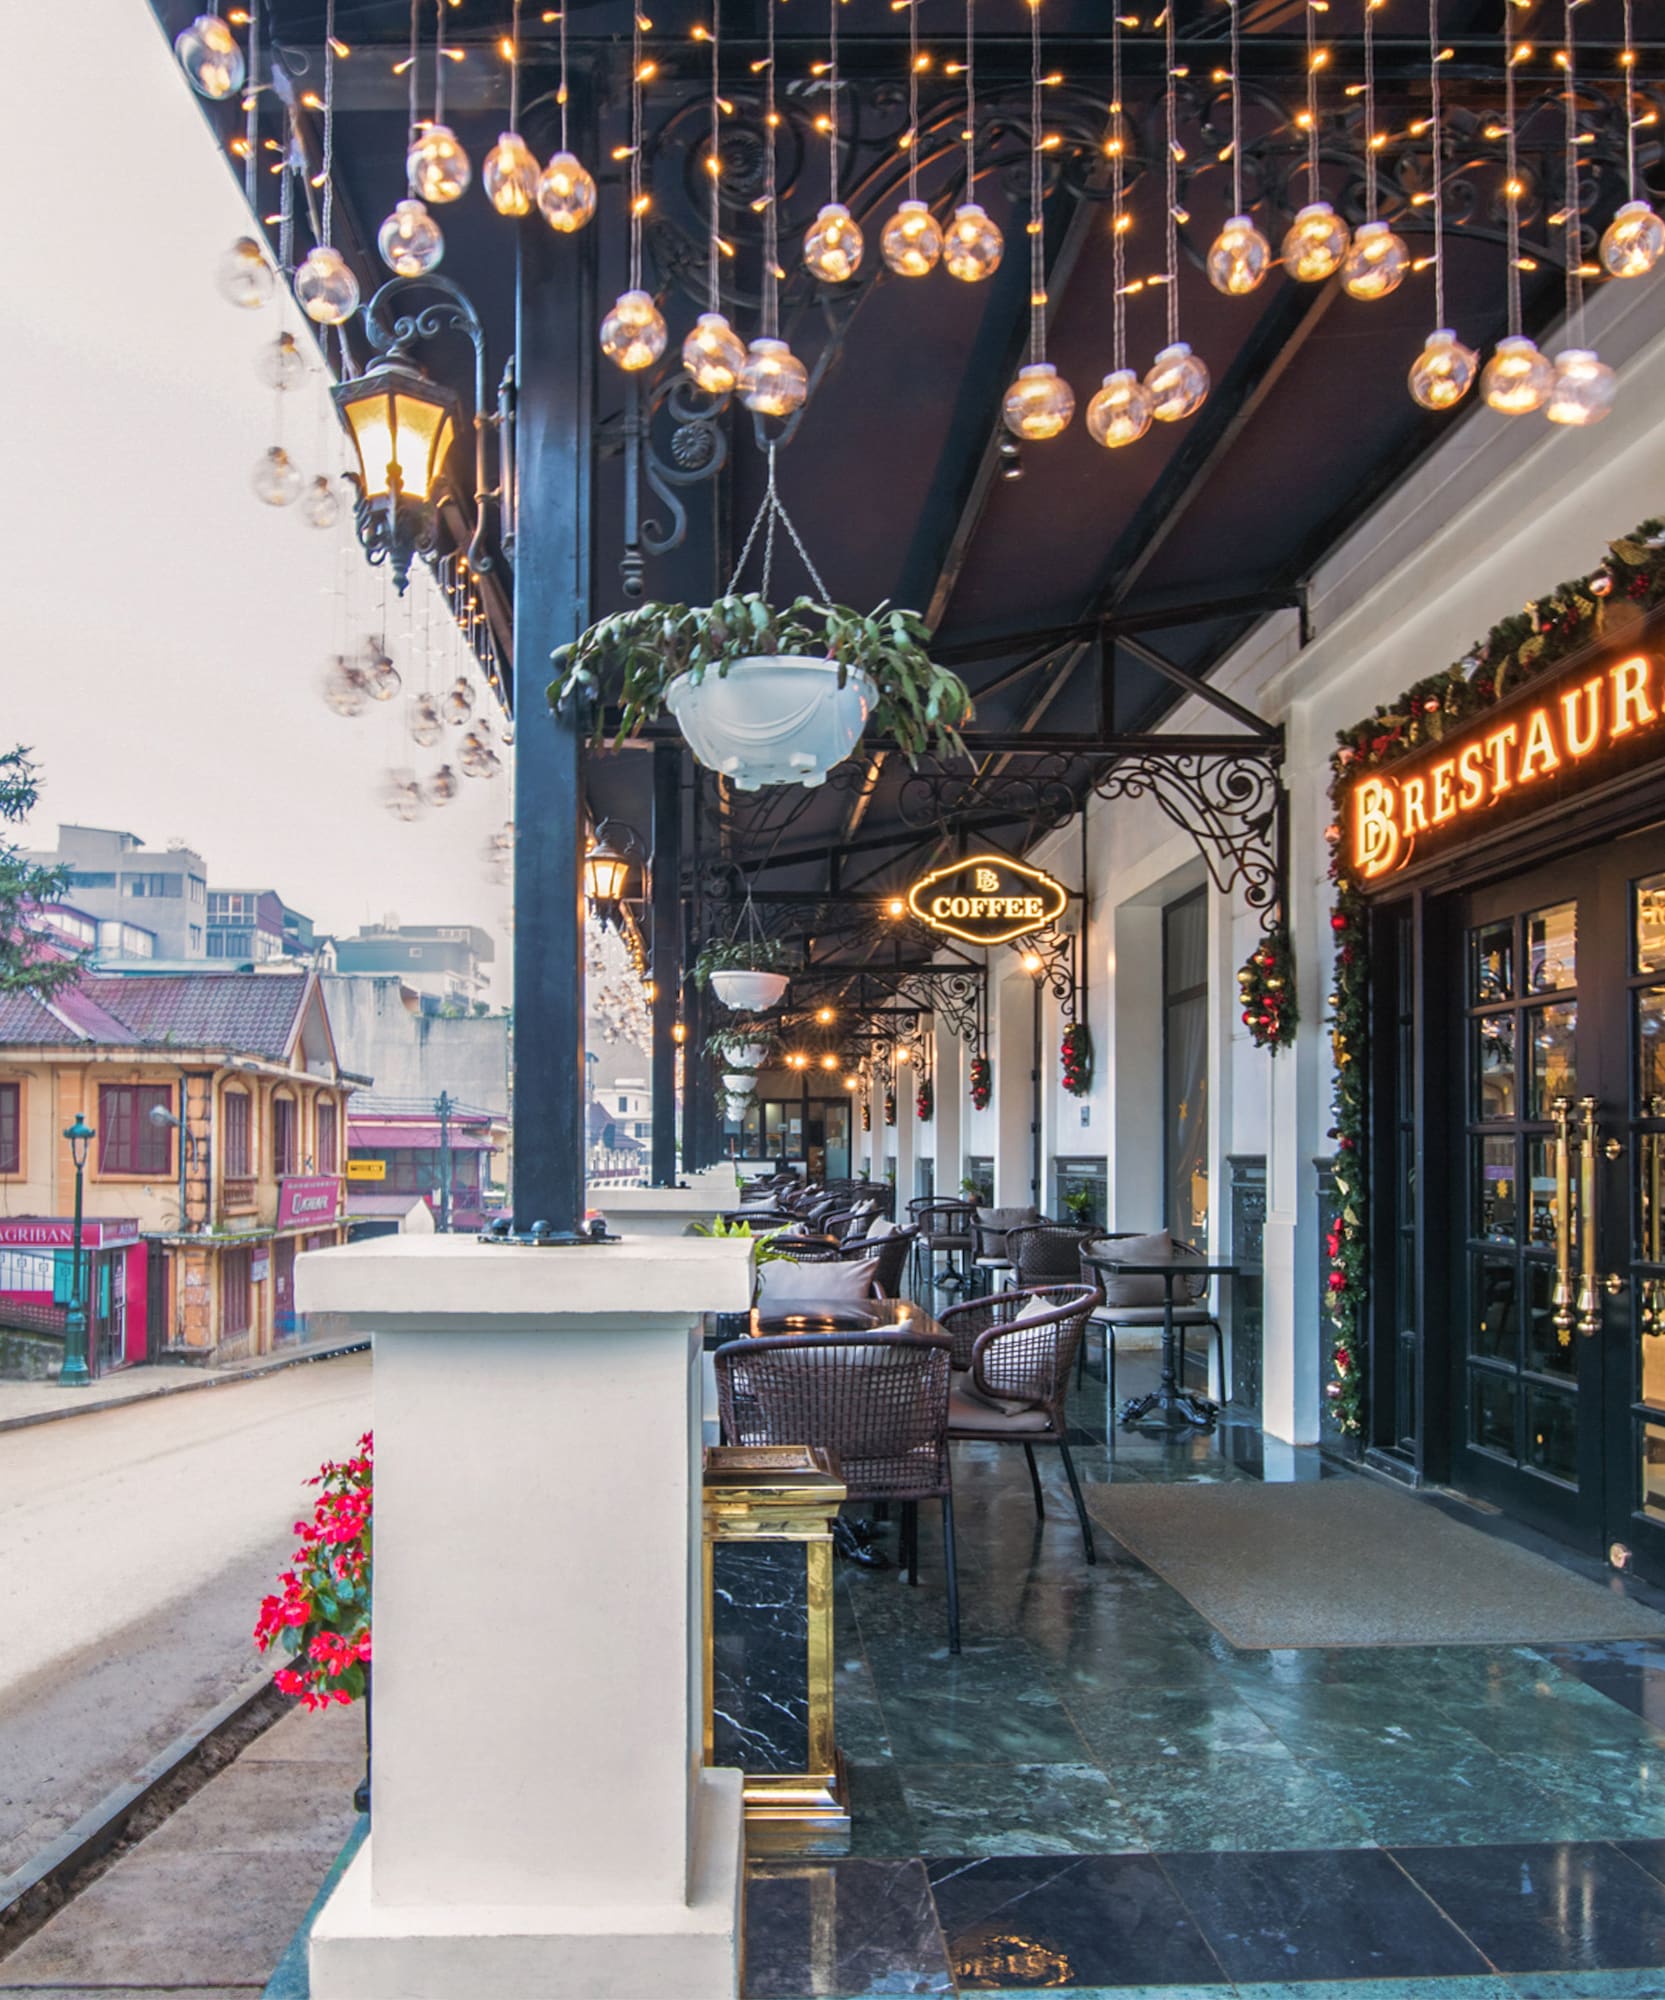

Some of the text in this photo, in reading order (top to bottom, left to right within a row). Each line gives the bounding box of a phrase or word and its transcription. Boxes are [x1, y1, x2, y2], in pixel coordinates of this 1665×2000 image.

[1401, 656, 1665, 838] RESTAUR
[932, 896, 1044, 918] COFFEE
[0, 1228, 84, 1243] GRIBAN
